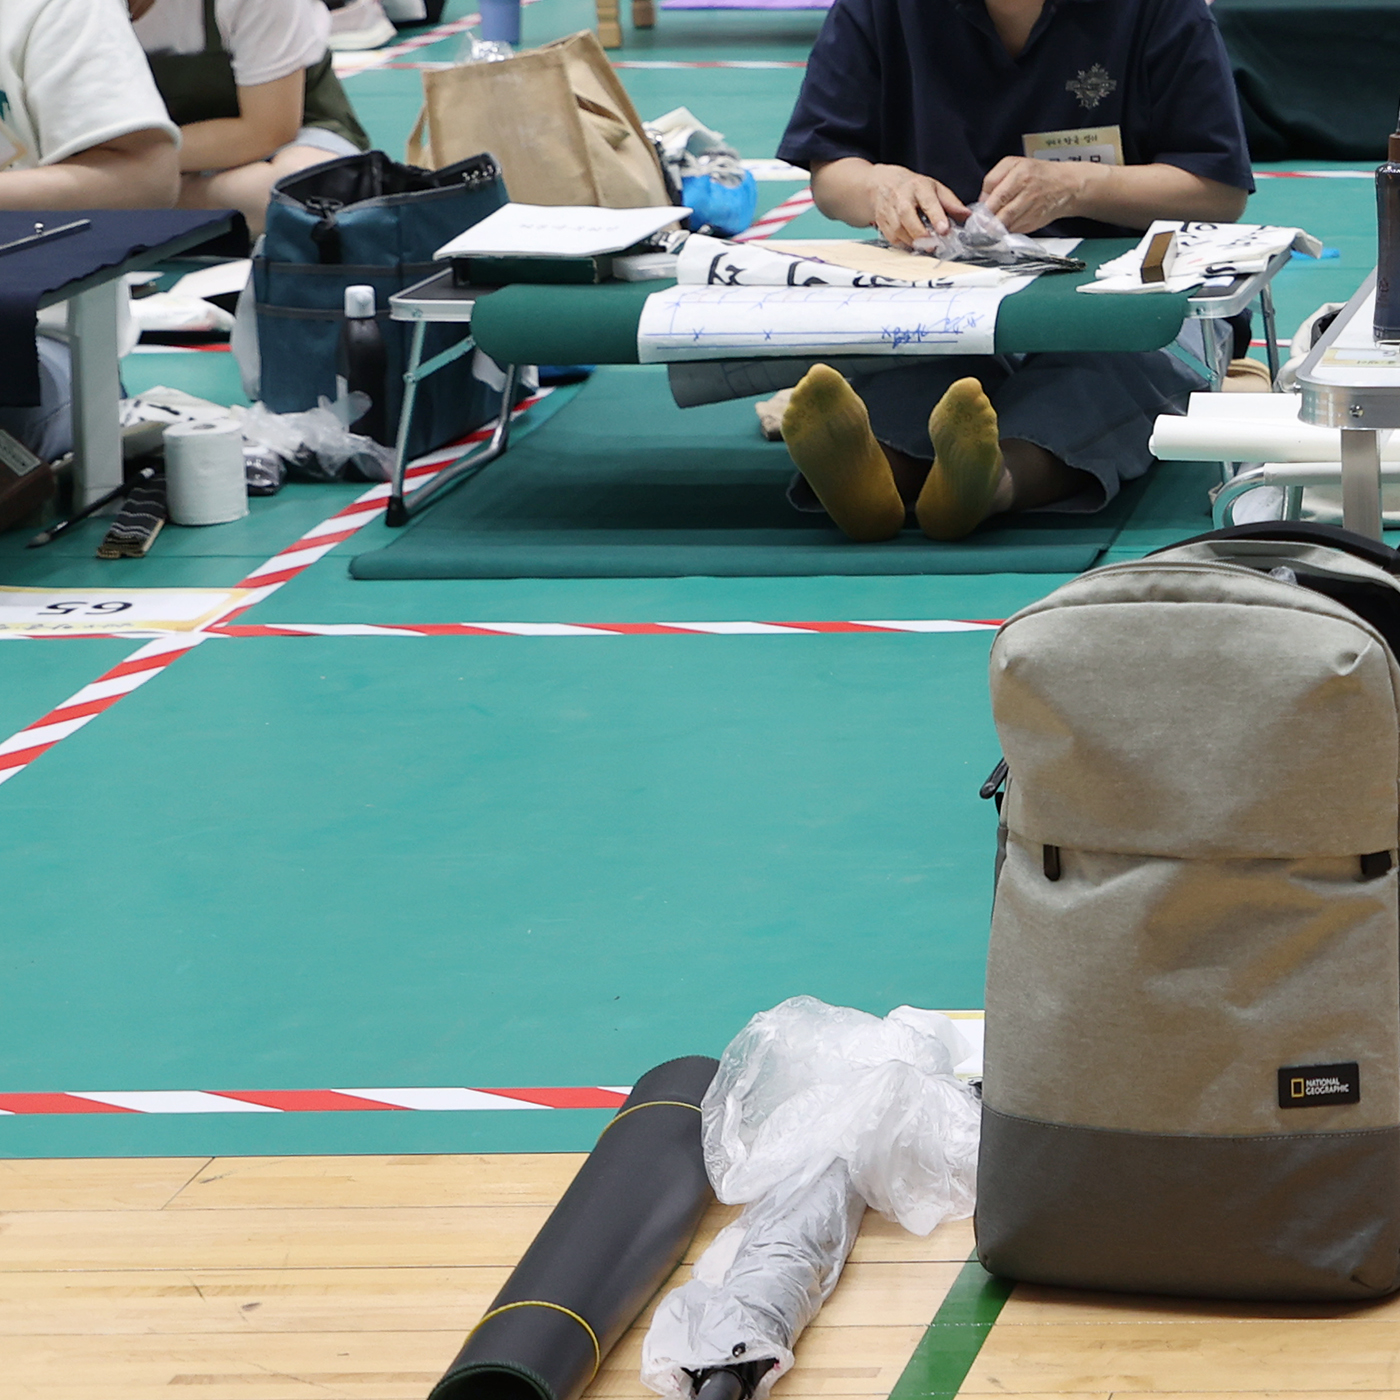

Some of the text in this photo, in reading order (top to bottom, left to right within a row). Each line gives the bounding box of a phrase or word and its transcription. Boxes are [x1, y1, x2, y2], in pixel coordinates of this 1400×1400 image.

[36, 601, 133, 615] 65
[1306, 1077, 1340, 1087] NATIONAL
[1306, 1084, 1349, 1095] GEOGRAPHIC
